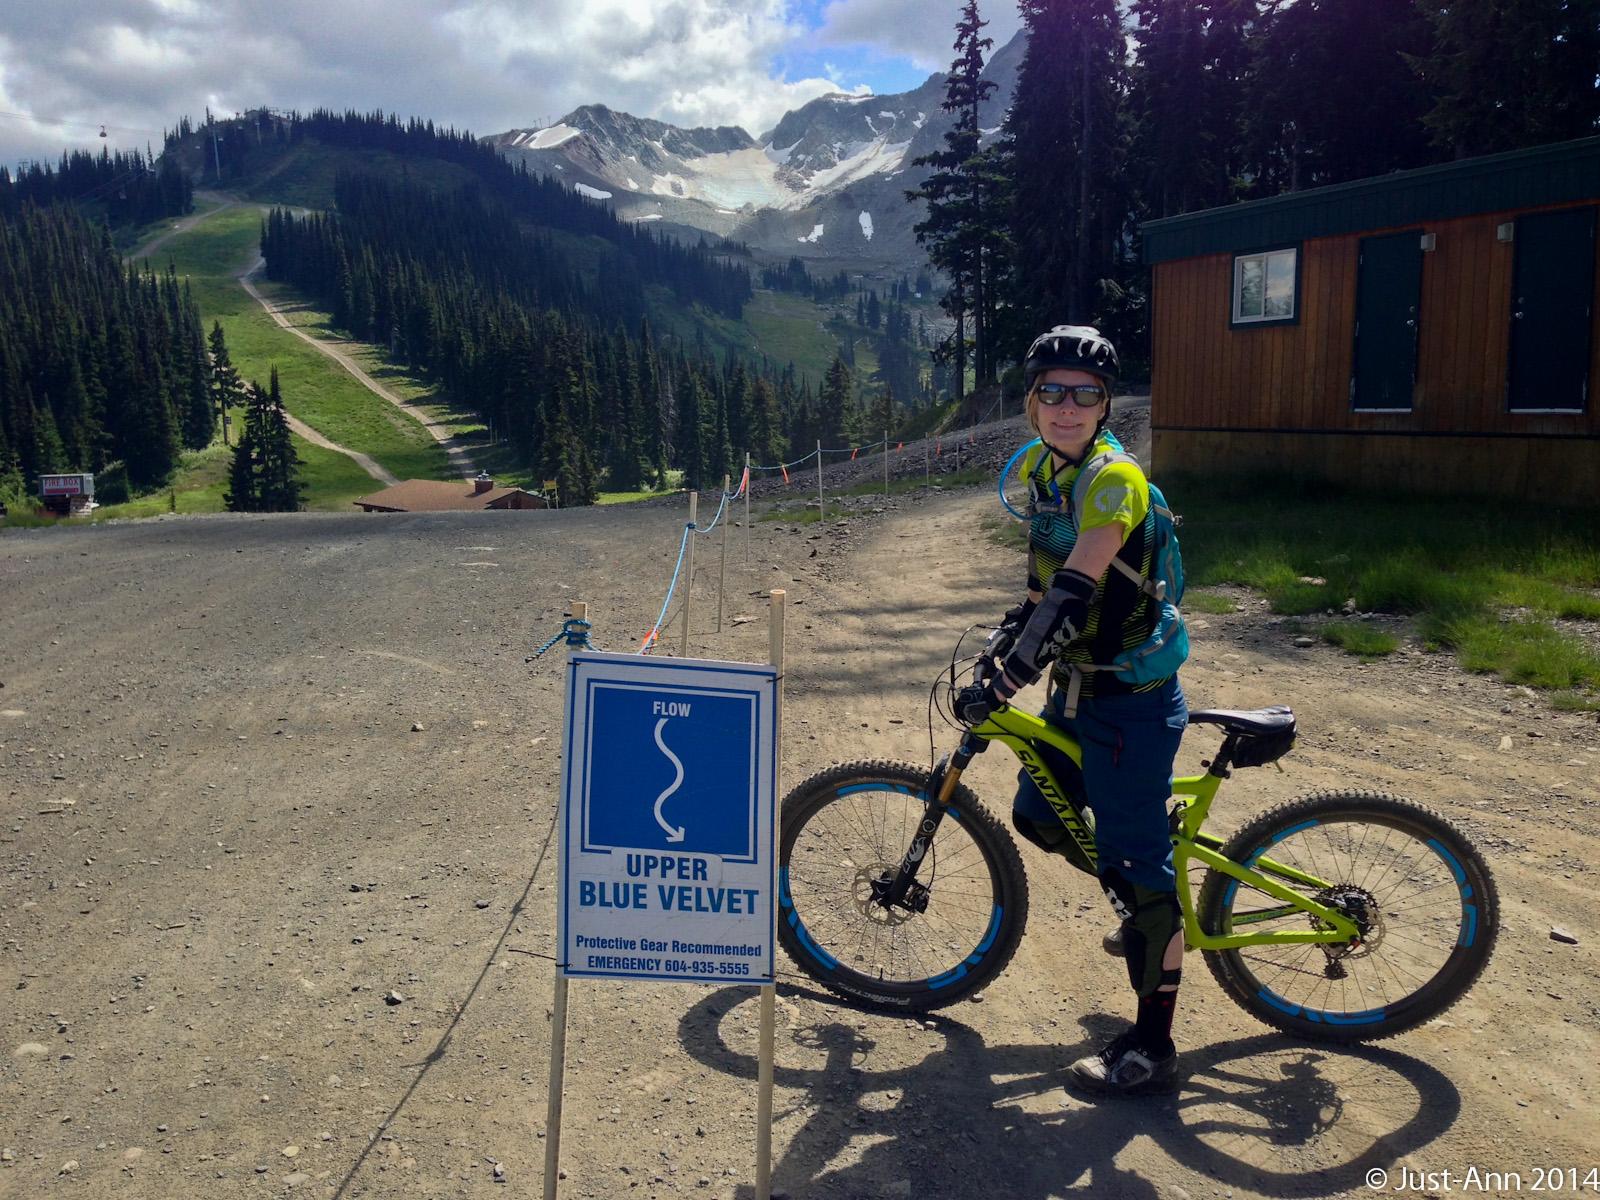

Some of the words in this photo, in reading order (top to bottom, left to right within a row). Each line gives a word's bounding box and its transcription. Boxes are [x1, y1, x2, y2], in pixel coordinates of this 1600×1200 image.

[63, 478, 79, 486] BOX
[653, 701, 691, 717] FLOW
[1018, 749, 1071, 814] SANTA
[626, 854, 708, 881] UPPER
[579, 880, 648, 910] BLUE
[658, 884, 760, 915] VELVET
[576, 935, 637, 951] Protective
[640, 938, 668, 953] Gear
[671, 940, 762, 957] Recommended
[588, 955, 663, 971] EMERGENCY
[665, 959, 750, 975] 604-935-5555
